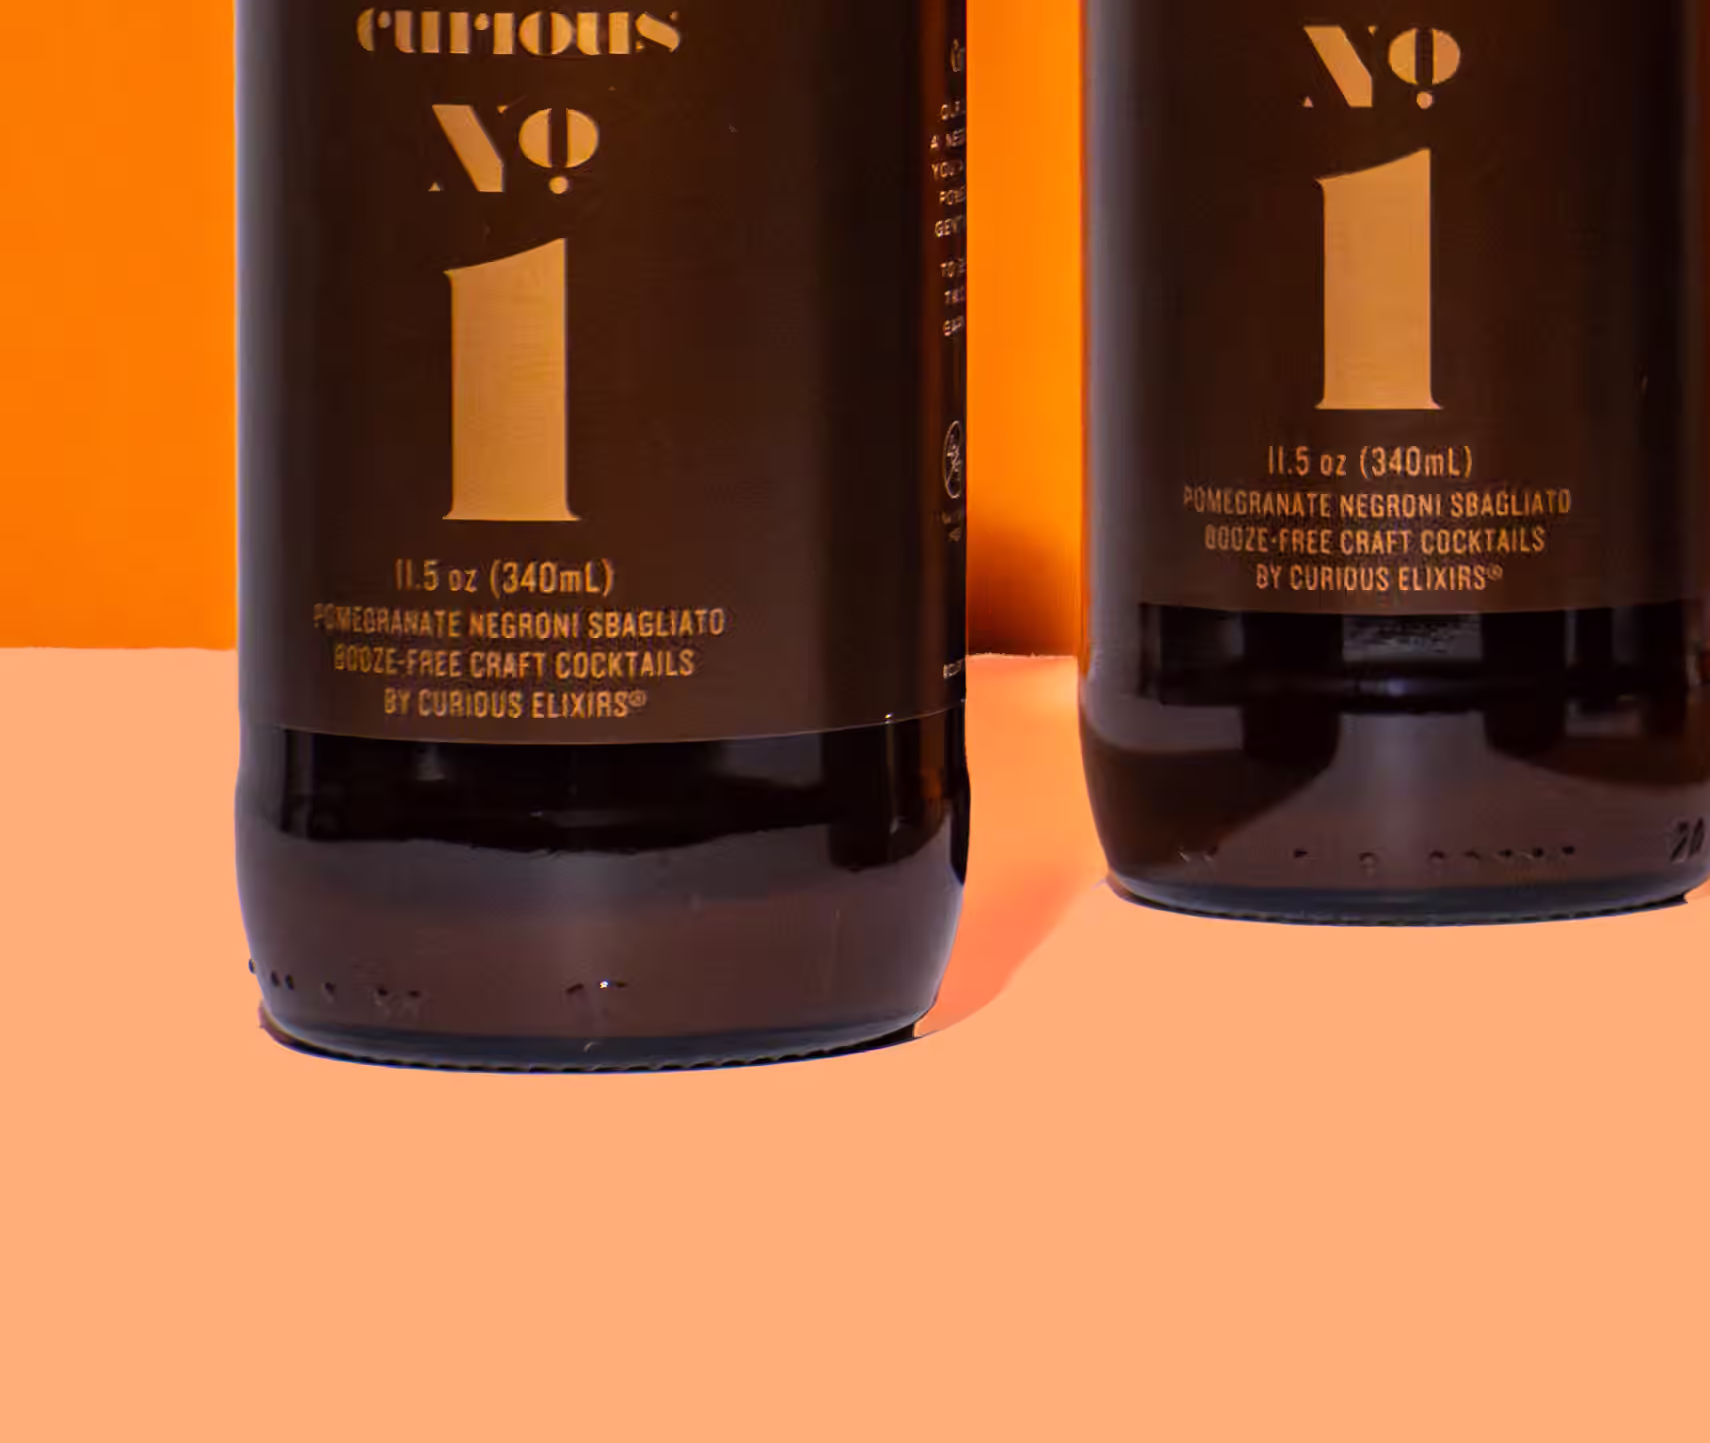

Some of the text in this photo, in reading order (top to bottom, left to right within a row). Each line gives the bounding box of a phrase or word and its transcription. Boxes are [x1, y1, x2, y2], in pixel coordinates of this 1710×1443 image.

[356, 7, 681, 56] curious
[1316, 147, 1443, 410] 1
[442, 238, 580, 522] 1
[1267, 445, 1309, 476] 11.5
[1320, 454, 1347, 476] oz
[1184, 486, 1571, 518] POMEGRANATE NEGRONI SBAGLIATO
[1204, 525, 1545, 555] BOOZE-FREE CRAFT COCKTAILS
[394, 559, 440, 592] 11.5
[448, 568, 478, 593] oz
[1256, 564, 1280, 589] BY
[1289, 566, 1389, 591] CURIOUS
[314, 603, 726, 639] POMEGRANATE NEGRONI SBAGLIATO
[334, 644, 695, 679] BOOZE-FREE CRAFT COCKTAILS
[384, 687, 411, 715] BY
[418, 689, 522, 718] CURIOUS
